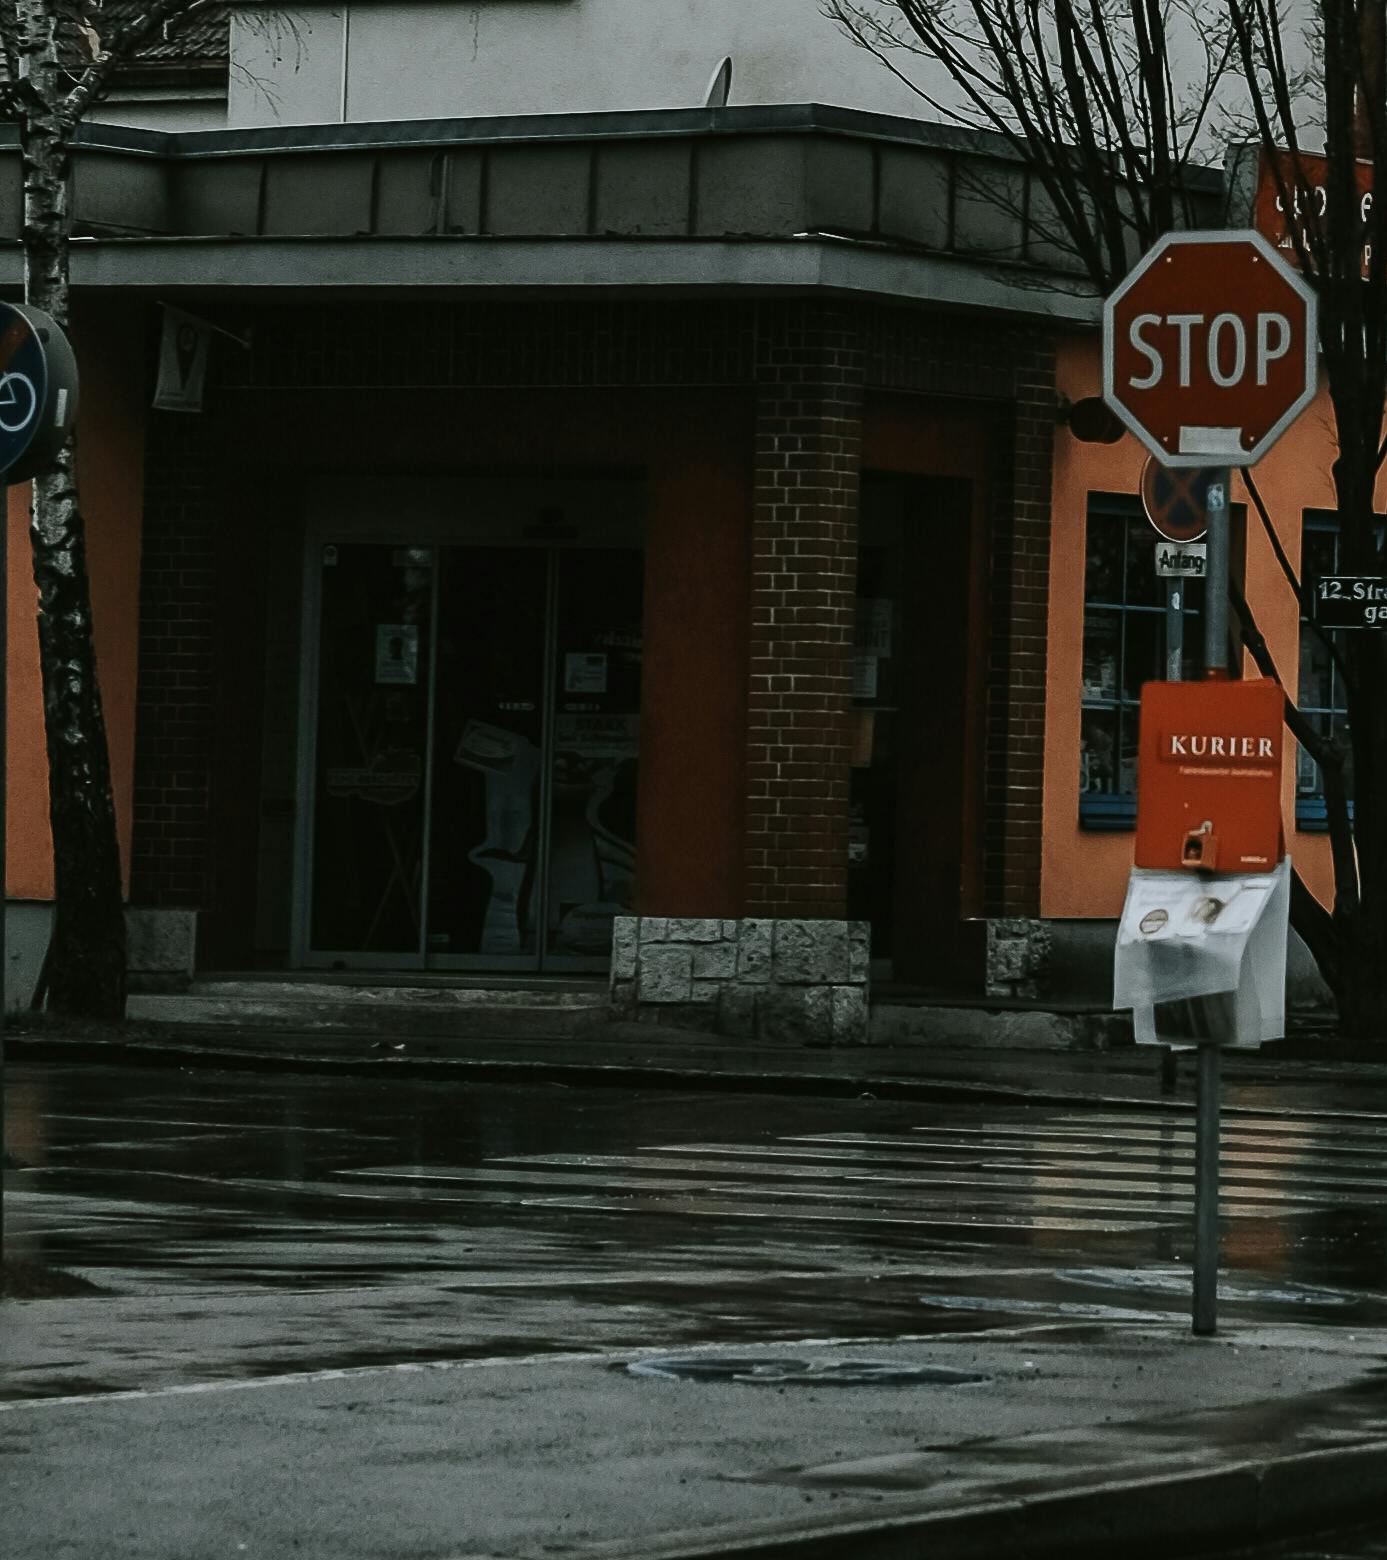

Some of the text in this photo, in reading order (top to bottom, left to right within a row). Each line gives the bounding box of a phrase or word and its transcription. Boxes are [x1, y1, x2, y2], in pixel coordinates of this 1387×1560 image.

[1128, 312, 1292, 390] STOP
[1158, 548, 1206, 577] Anfang
[1171, 735, 1274, 757] KURIER
